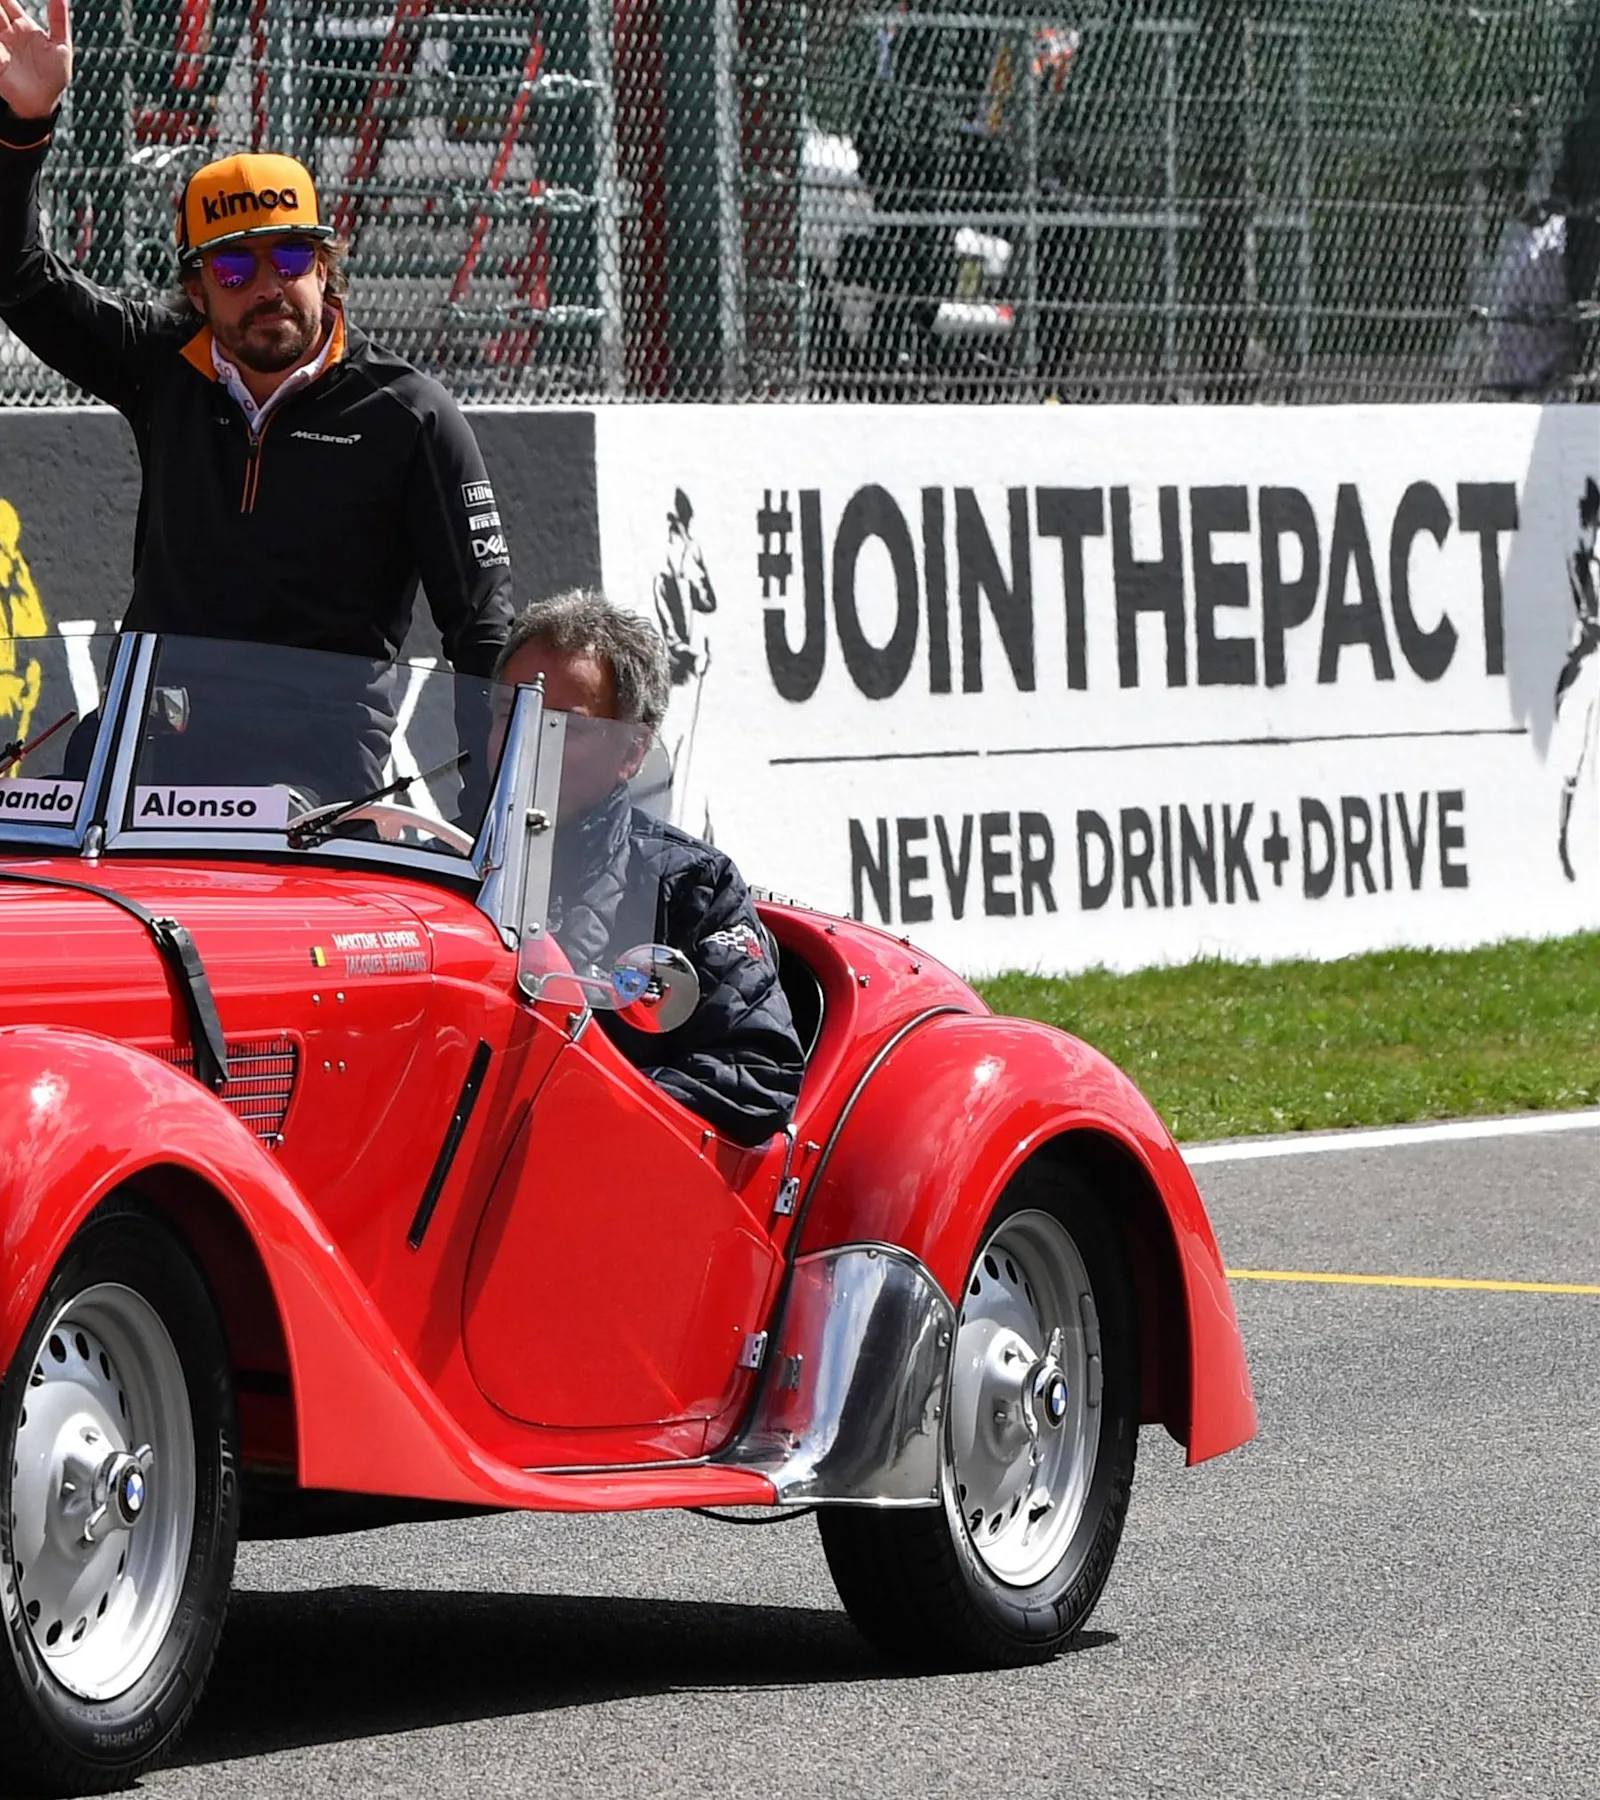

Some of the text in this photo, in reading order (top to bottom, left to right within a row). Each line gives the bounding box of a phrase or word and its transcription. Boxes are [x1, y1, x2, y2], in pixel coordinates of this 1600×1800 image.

[202, 189, 299, 224] kimoa
[290, 430, 353, 445] McLaren
[757, 480, 1518, 703] #JOINTHEPACT
[140, 792, 257, 818] Alonso
[849, 790, 1469, 926] NEVER DRINK+DRIVE
